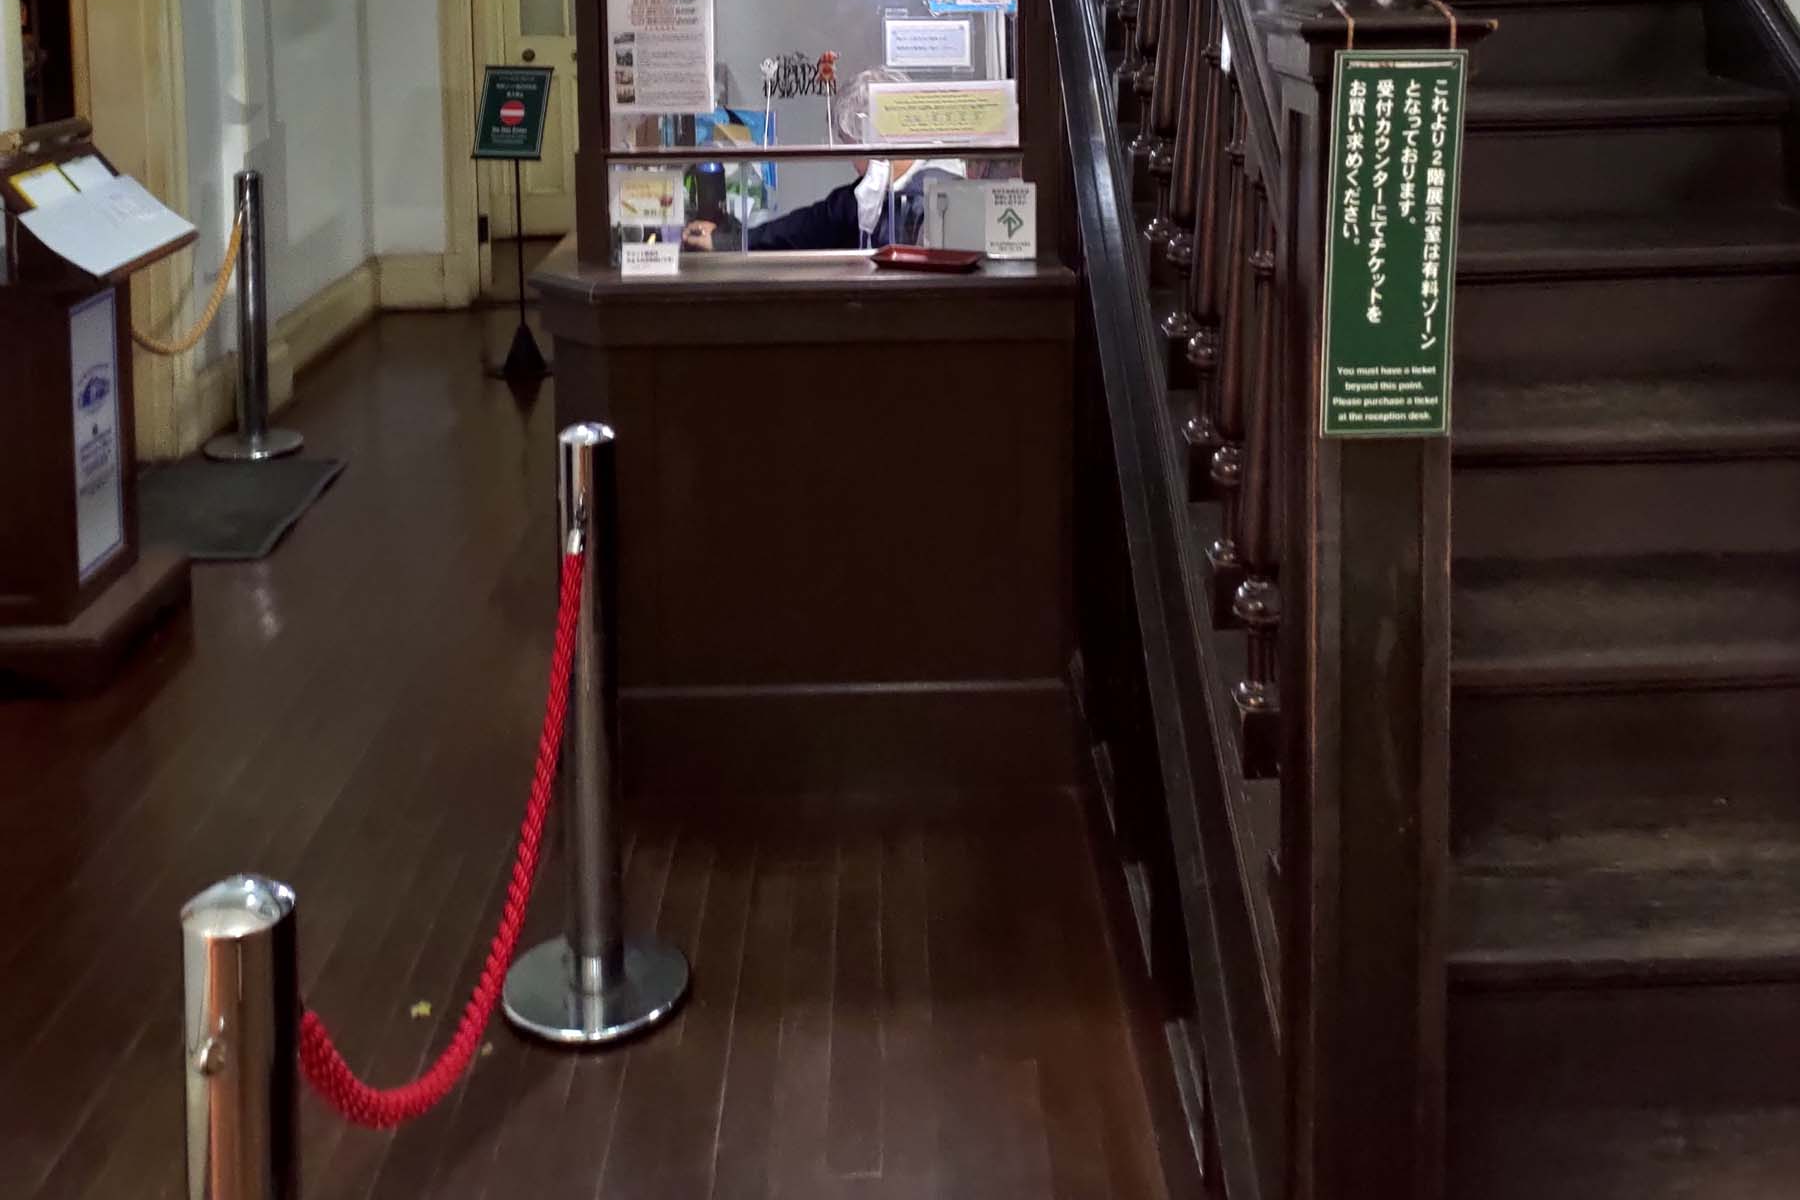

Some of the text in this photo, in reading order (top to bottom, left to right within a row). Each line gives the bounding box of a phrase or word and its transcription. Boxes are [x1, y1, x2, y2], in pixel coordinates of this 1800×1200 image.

[1343, 79, 1367, 246] お買い求めください。
[1398, 78, 1422, 225] となっております。
[1366, 78, 1395, 324] 受付カウンターにてチケットを
[1421, 79, 1450, 350] これより2階展示室は有料ゾーン
[1332, 396, 1439, 408] Please purchase a ticket
[1337, 366, 1355, 375] You
[1356, 366, 1379, 375] must
[1380, 366, 1403, 375] have
[1411, 365, 1437, 375] ticket
[1345, 381, 1424, 392] beyond this point.
[1338, 411, 1432, 422] at the reception desk.
